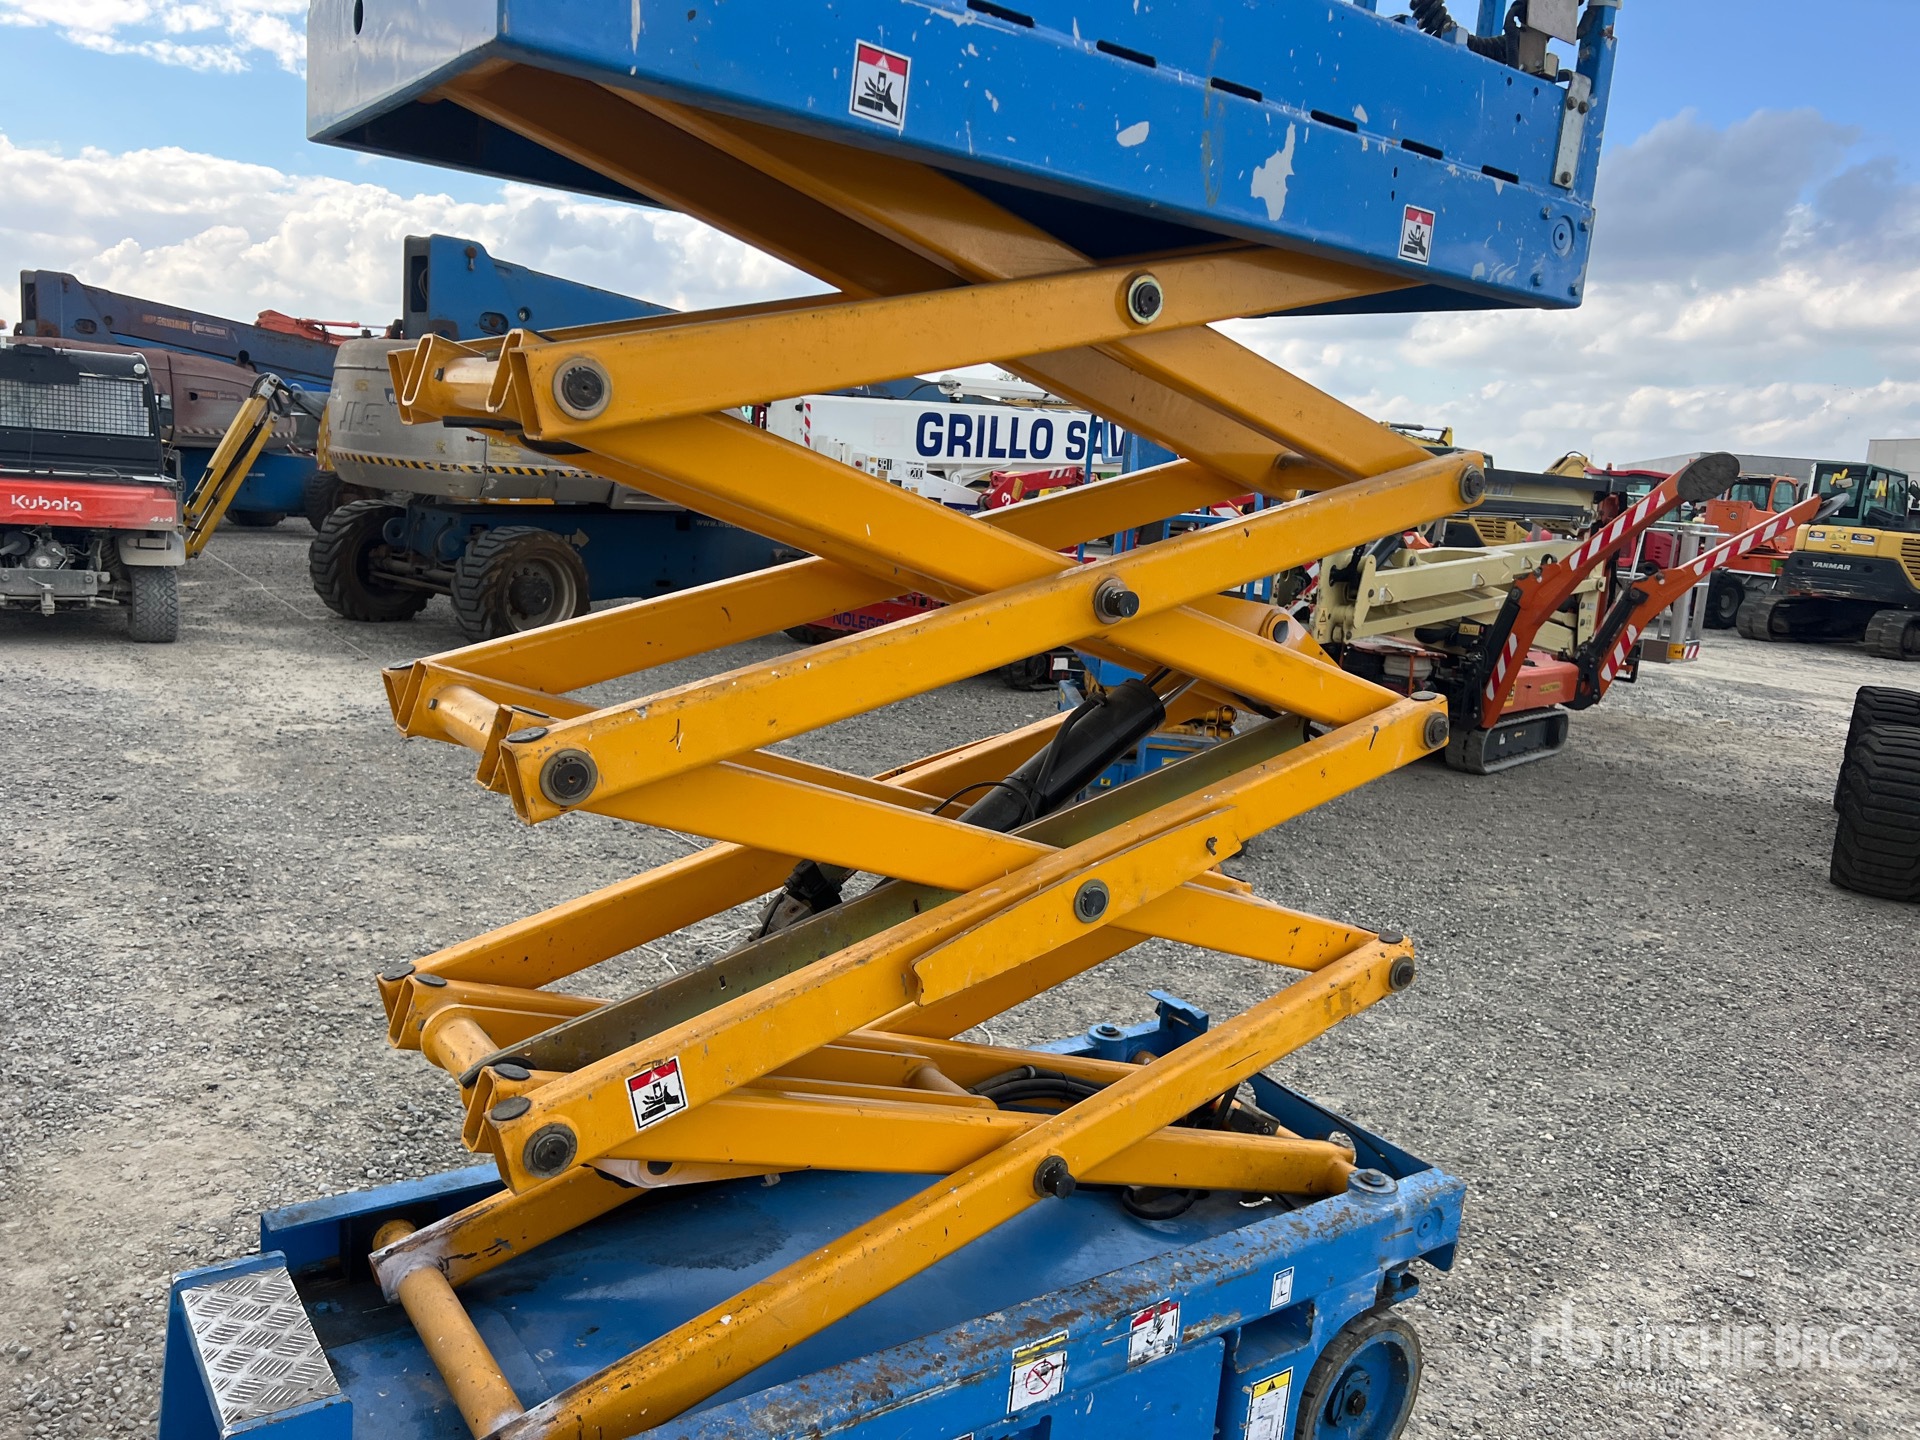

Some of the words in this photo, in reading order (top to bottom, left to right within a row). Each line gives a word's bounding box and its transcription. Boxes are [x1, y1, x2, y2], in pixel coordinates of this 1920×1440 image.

[915, 411, 1055, 460] GRILLO
[11, 494, 83, 511] Kubota
[150, 515, 174, 524] 4x4
[1811, 561, 1852, 571] YANMAR
